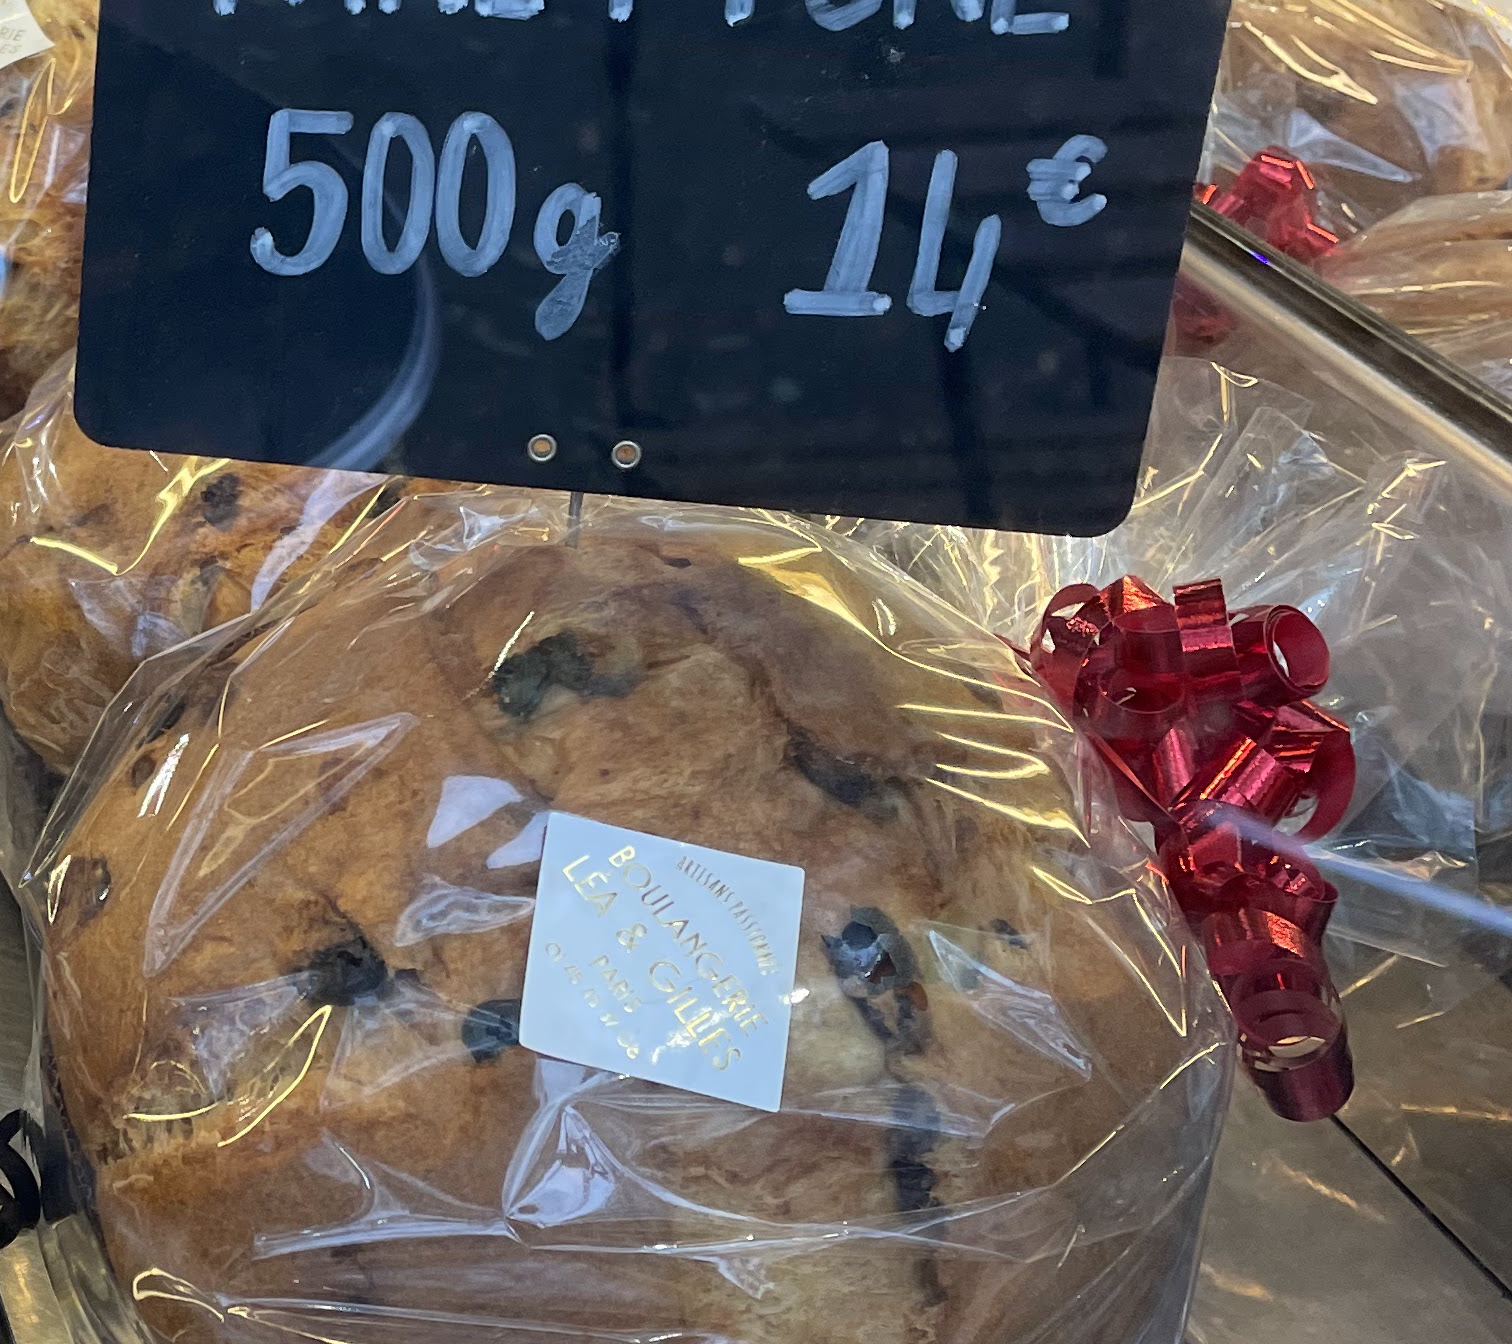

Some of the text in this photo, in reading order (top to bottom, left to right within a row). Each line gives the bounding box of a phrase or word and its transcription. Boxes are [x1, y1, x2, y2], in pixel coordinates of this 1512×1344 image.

[608, 845, 769, 1038] BOULANGERIE
[674, 855, 736, 904] ARTISANS
[562, 854, 742, 1071] LÉA & GILLES
[590, 954, 641, 1013] PARIS
